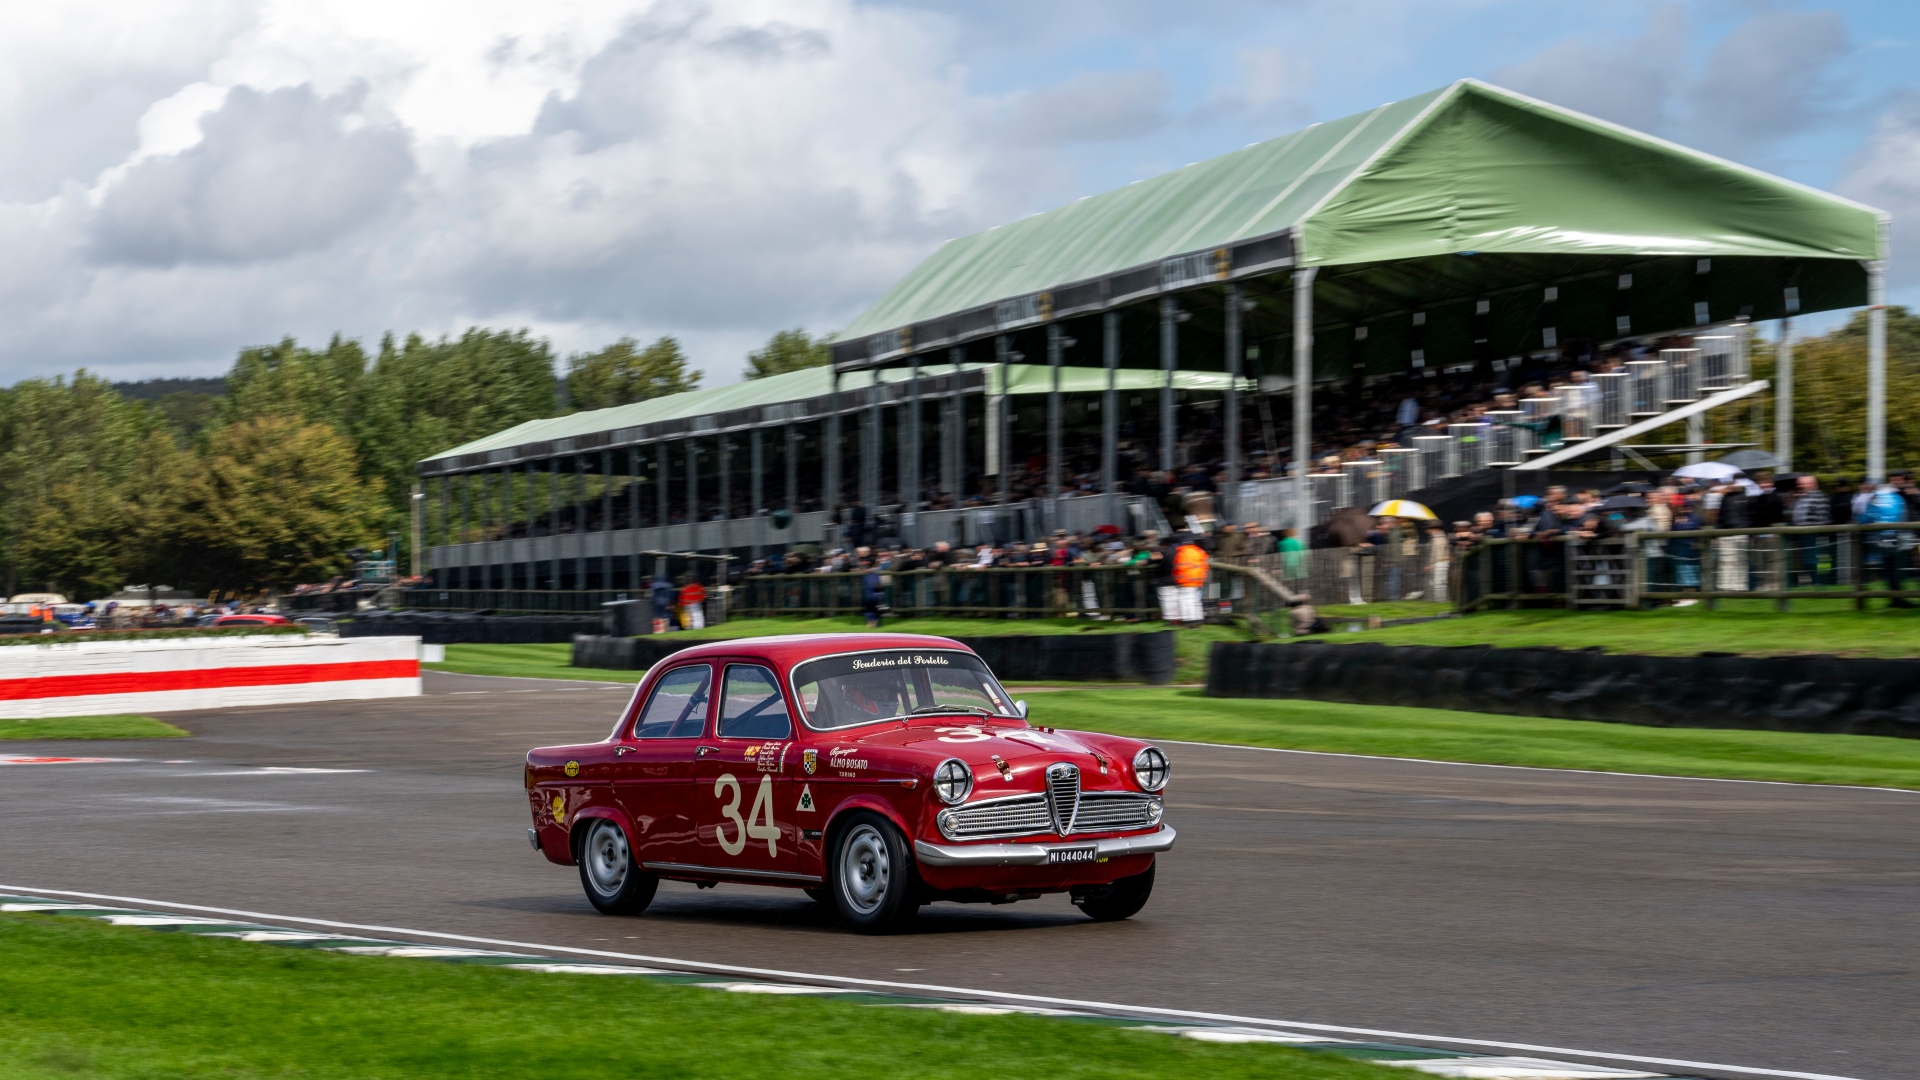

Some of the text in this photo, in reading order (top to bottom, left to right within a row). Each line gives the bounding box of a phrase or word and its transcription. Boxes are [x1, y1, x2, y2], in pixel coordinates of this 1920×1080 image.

[852, 655, 949, 670] Scuderia del Portello
[830, 757, 868, 770] ALMO BOSATO
[714, 773, 782, 859] 34
[1050, 851, 1093, 862] NI 044044
